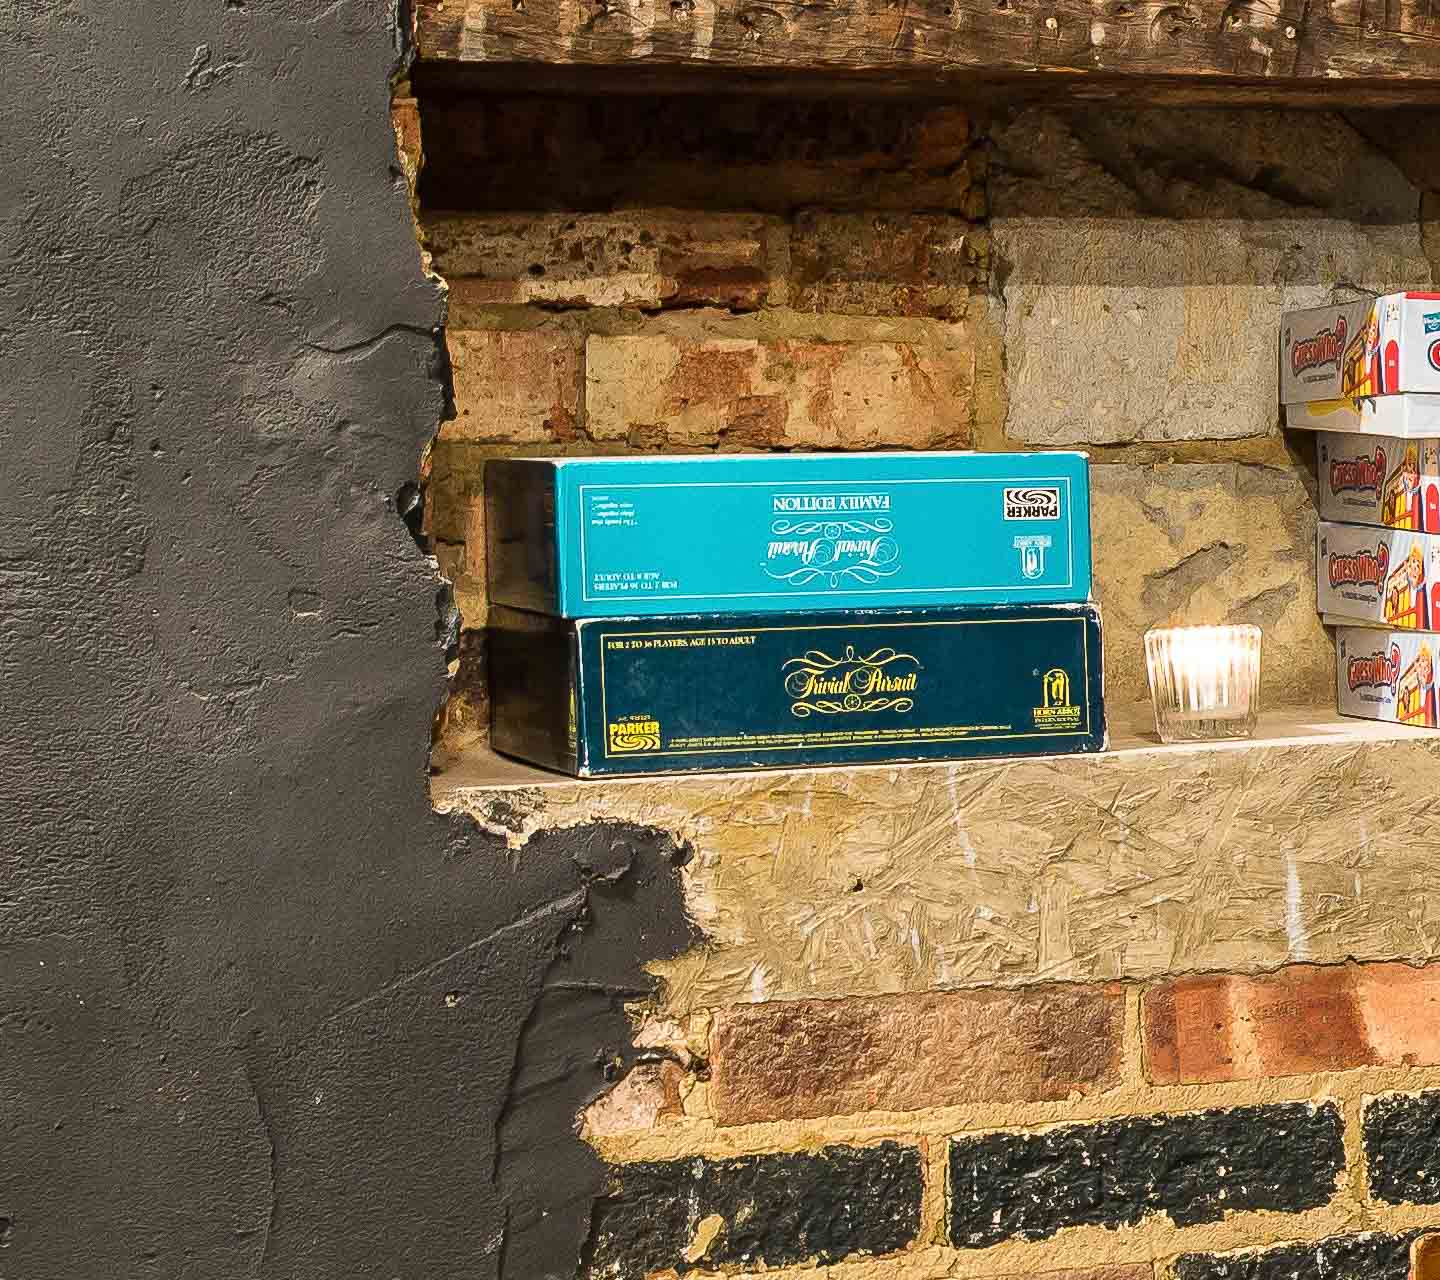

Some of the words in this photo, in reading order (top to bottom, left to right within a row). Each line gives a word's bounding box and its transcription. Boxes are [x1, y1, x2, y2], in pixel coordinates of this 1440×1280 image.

[773, 496, 836, 511] EDITION
[838, 495, 890, 511] FAMILY
[1006, 505, 1058, 518] PARKER
[784, 668, 852, 700] Trivial
[850, 667, 919, 697] Pursuit
[609, 721, 660, 736] PARKER
